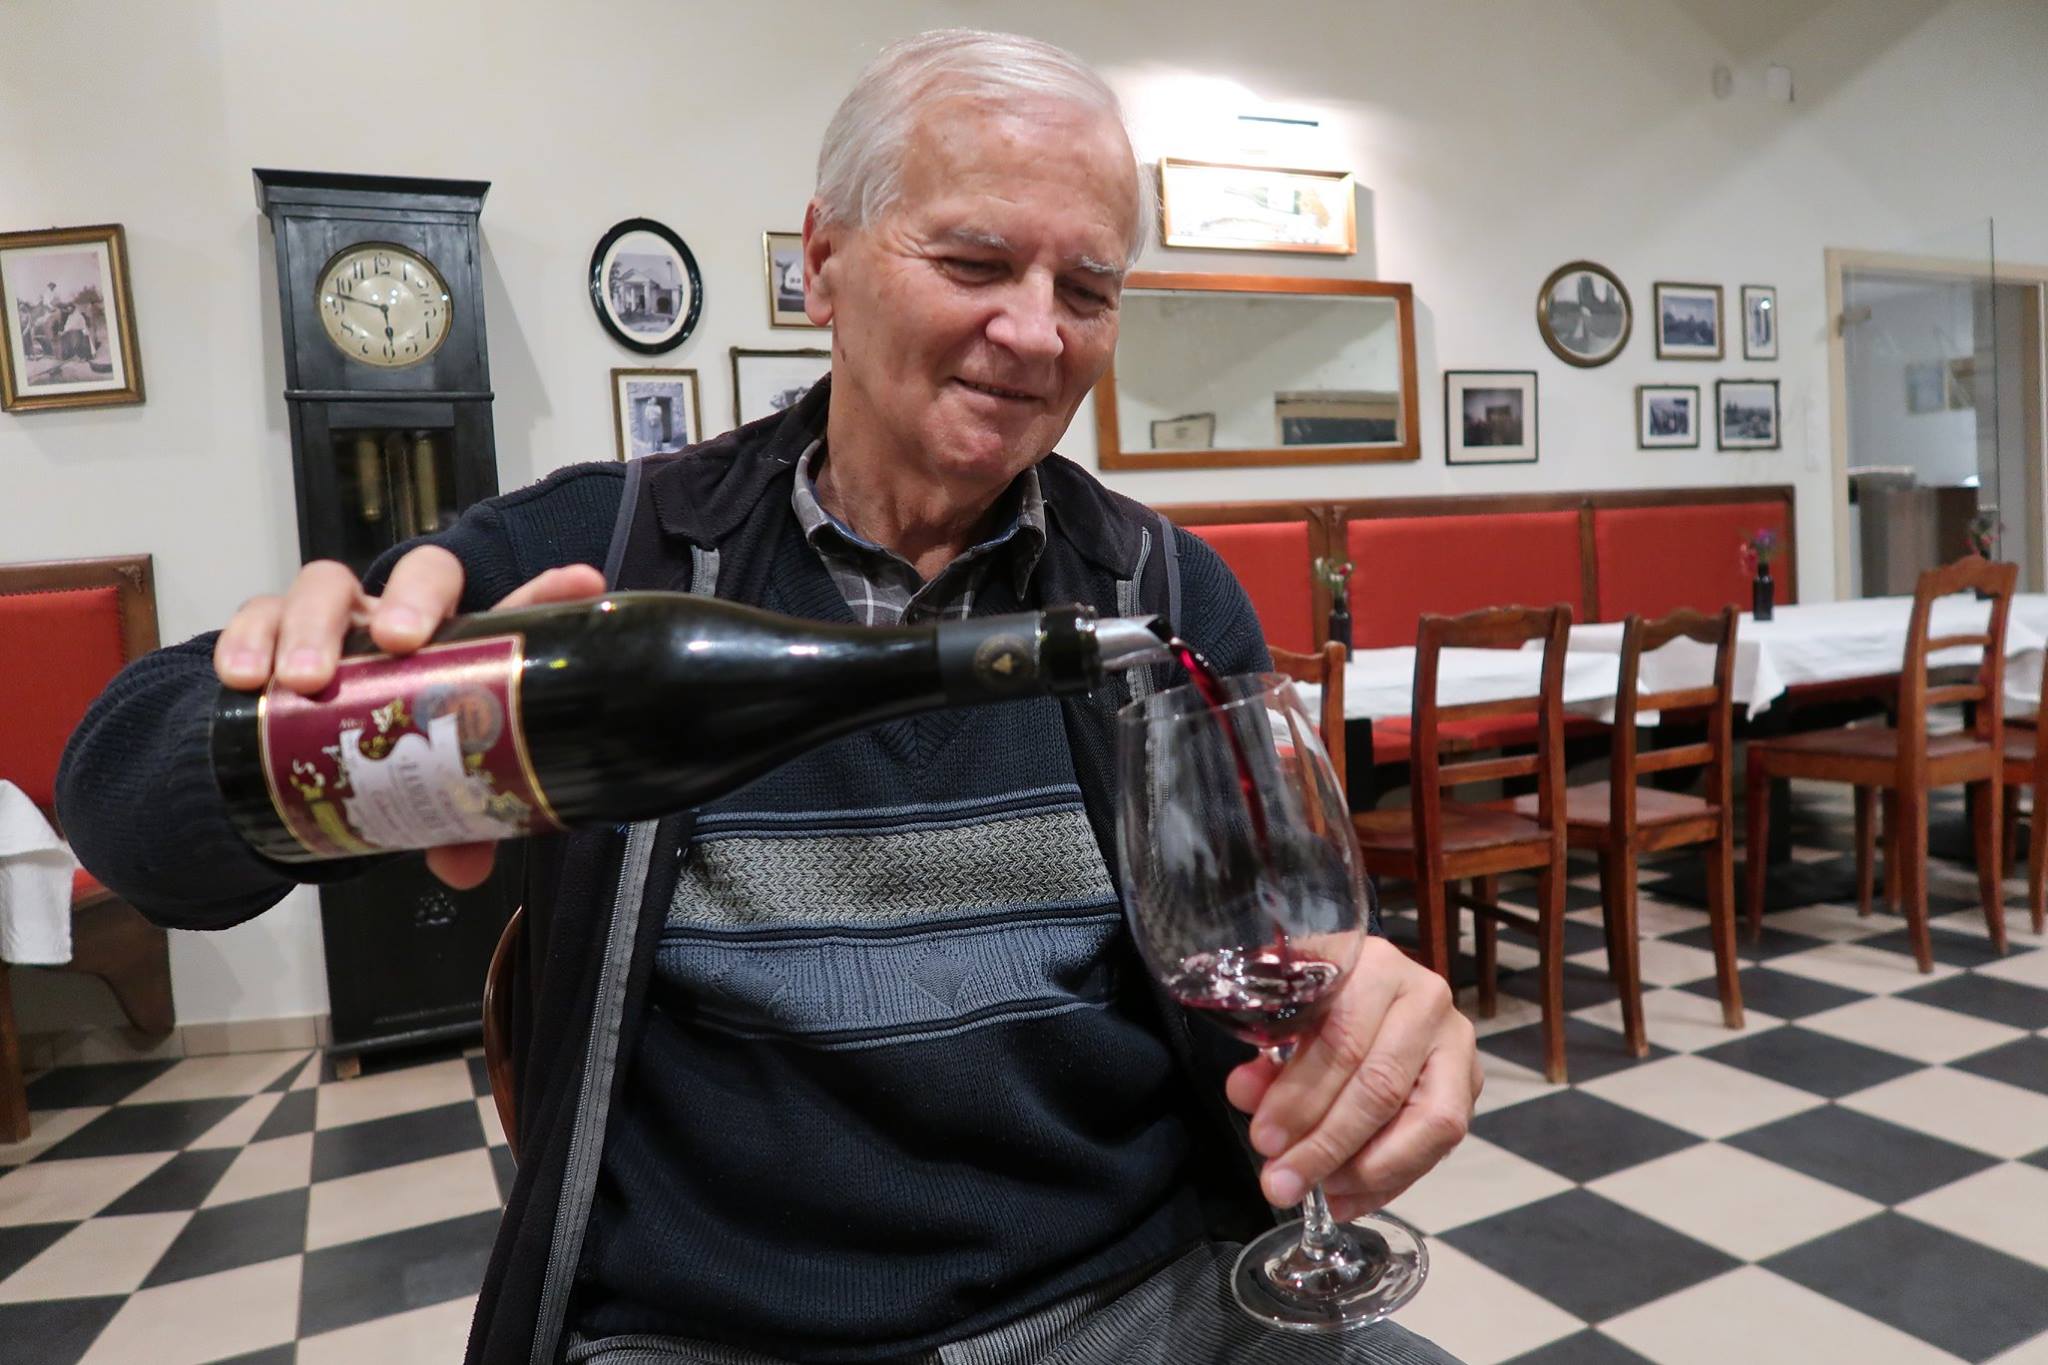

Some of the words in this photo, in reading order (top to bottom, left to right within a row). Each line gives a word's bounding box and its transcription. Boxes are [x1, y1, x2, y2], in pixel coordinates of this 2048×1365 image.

[353, 261, 364, 279] 11
[375, 256, 391, 275] 12
[402, 263, 408, 280] 1
[336, 277, 352, 296] 10
